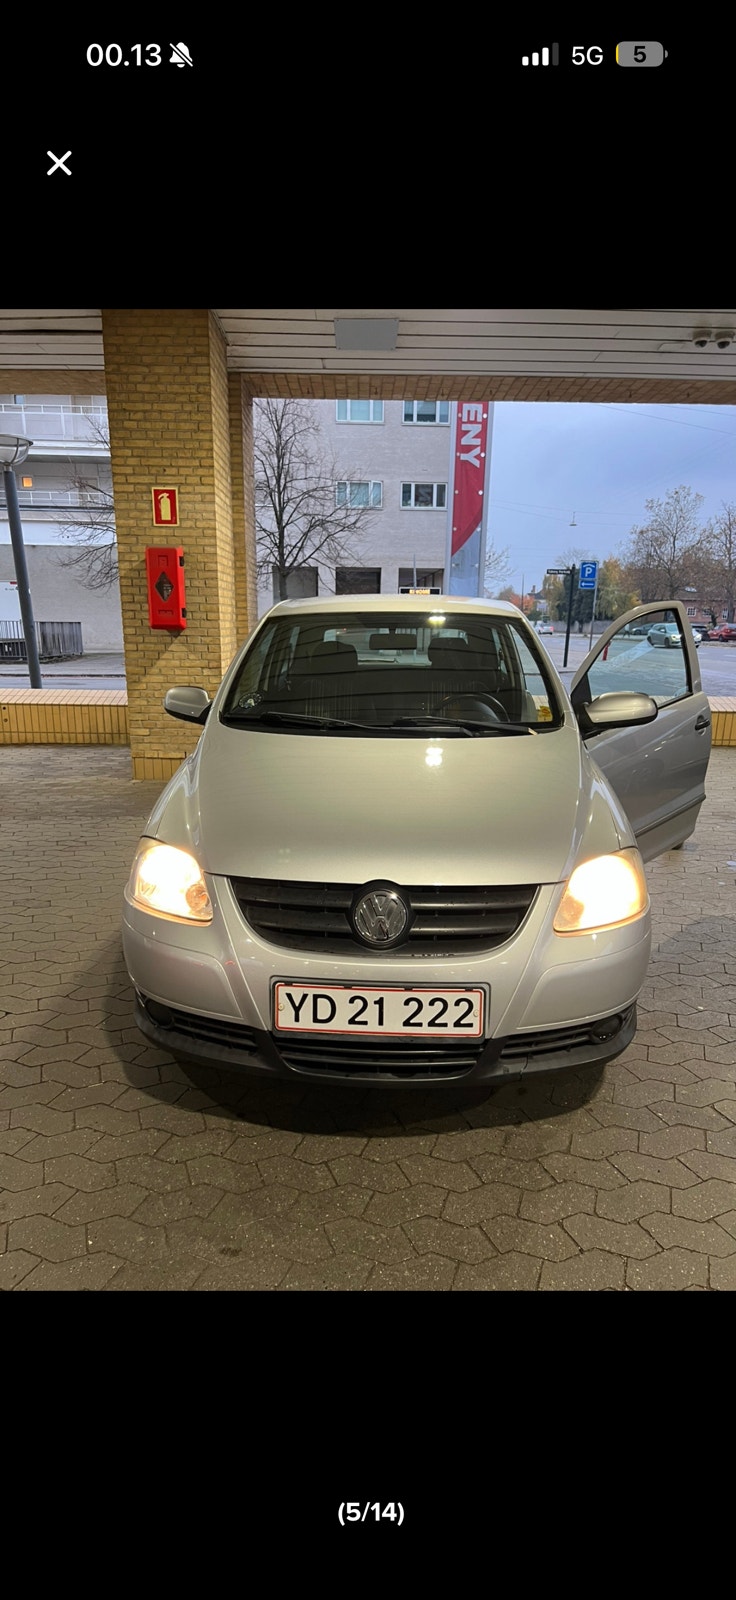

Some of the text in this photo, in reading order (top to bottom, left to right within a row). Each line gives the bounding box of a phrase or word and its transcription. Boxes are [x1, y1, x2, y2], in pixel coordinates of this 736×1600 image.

[460, 403, 484, 469] ENY
[585, 567, 593, 577] P
[285, 992, 474, 1028] YD 21 222
